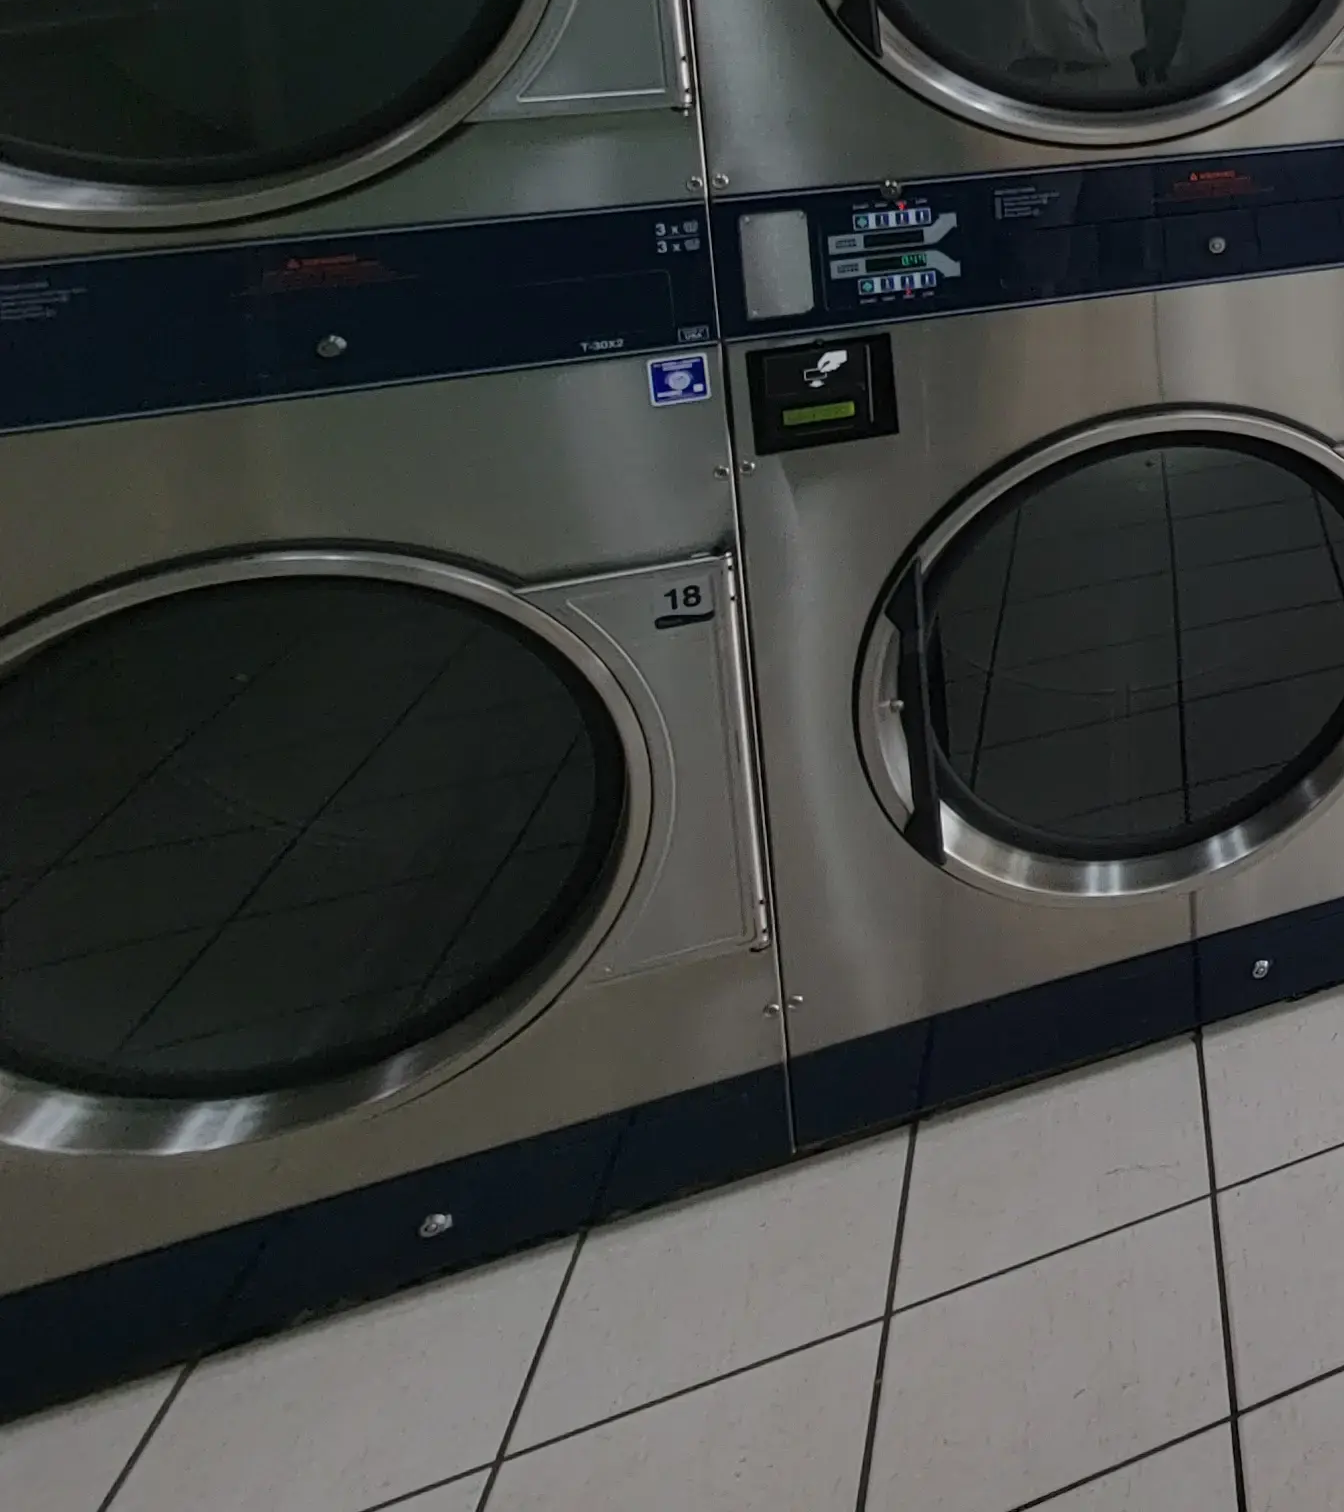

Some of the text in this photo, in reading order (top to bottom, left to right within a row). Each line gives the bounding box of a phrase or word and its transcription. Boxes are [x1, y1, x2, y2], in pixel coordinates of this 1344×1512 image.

[655, 223, 666, 236] 3
[656, 240, 668, 253] 3
[580, 338, 625, 353] T-30X2
[663, 584, 702, 610] 18
